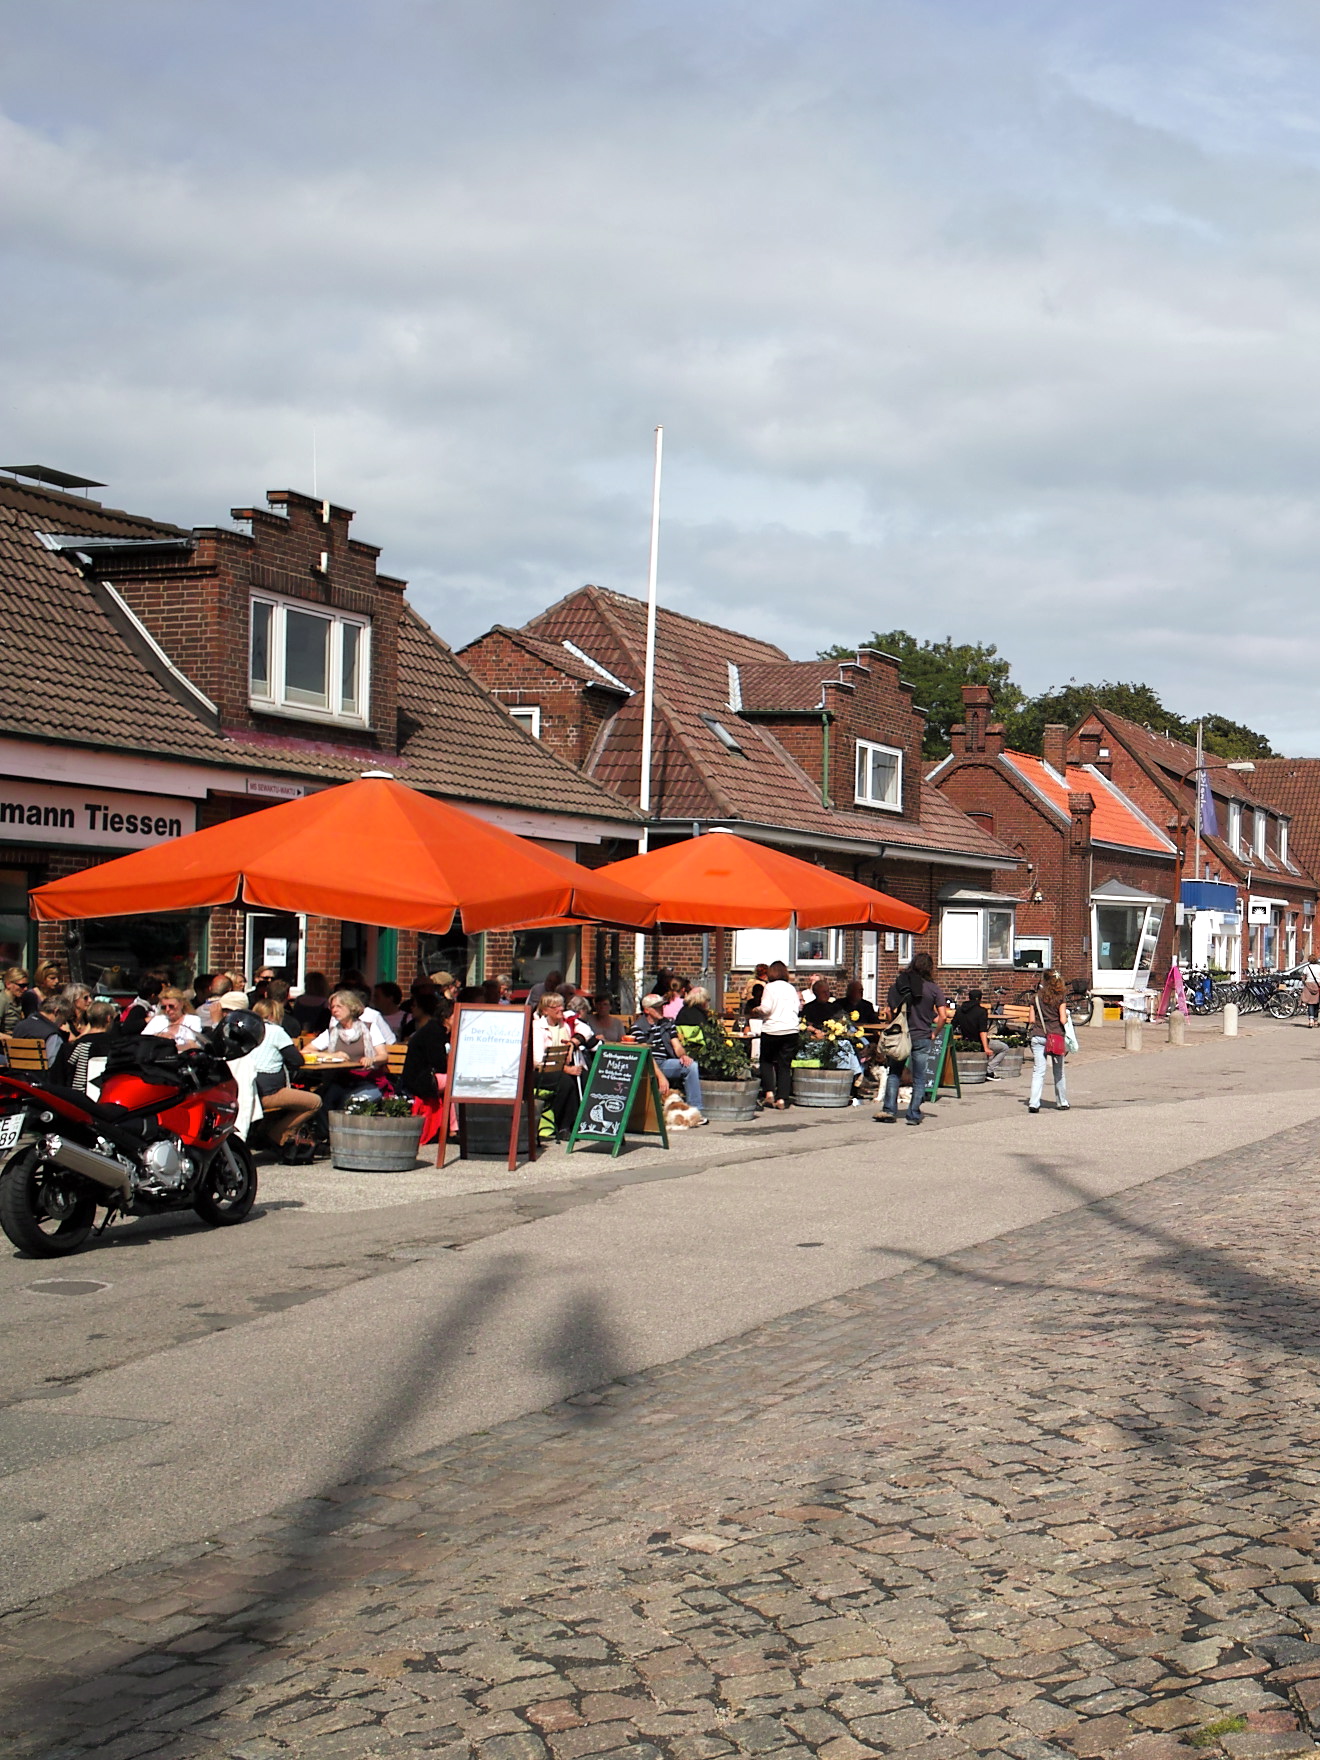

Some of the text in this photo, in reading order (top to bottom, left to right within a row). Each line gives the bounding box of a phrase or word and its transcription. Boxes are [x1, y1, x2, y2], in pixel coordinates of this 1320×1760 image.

[0, 802, 182, 837] mann Tiessen
[471, 1027, 485, 1035] Der
[464, 1034, 522, 1044] im Kofferraum
[607, 1060, 629, 1071] Matjes
